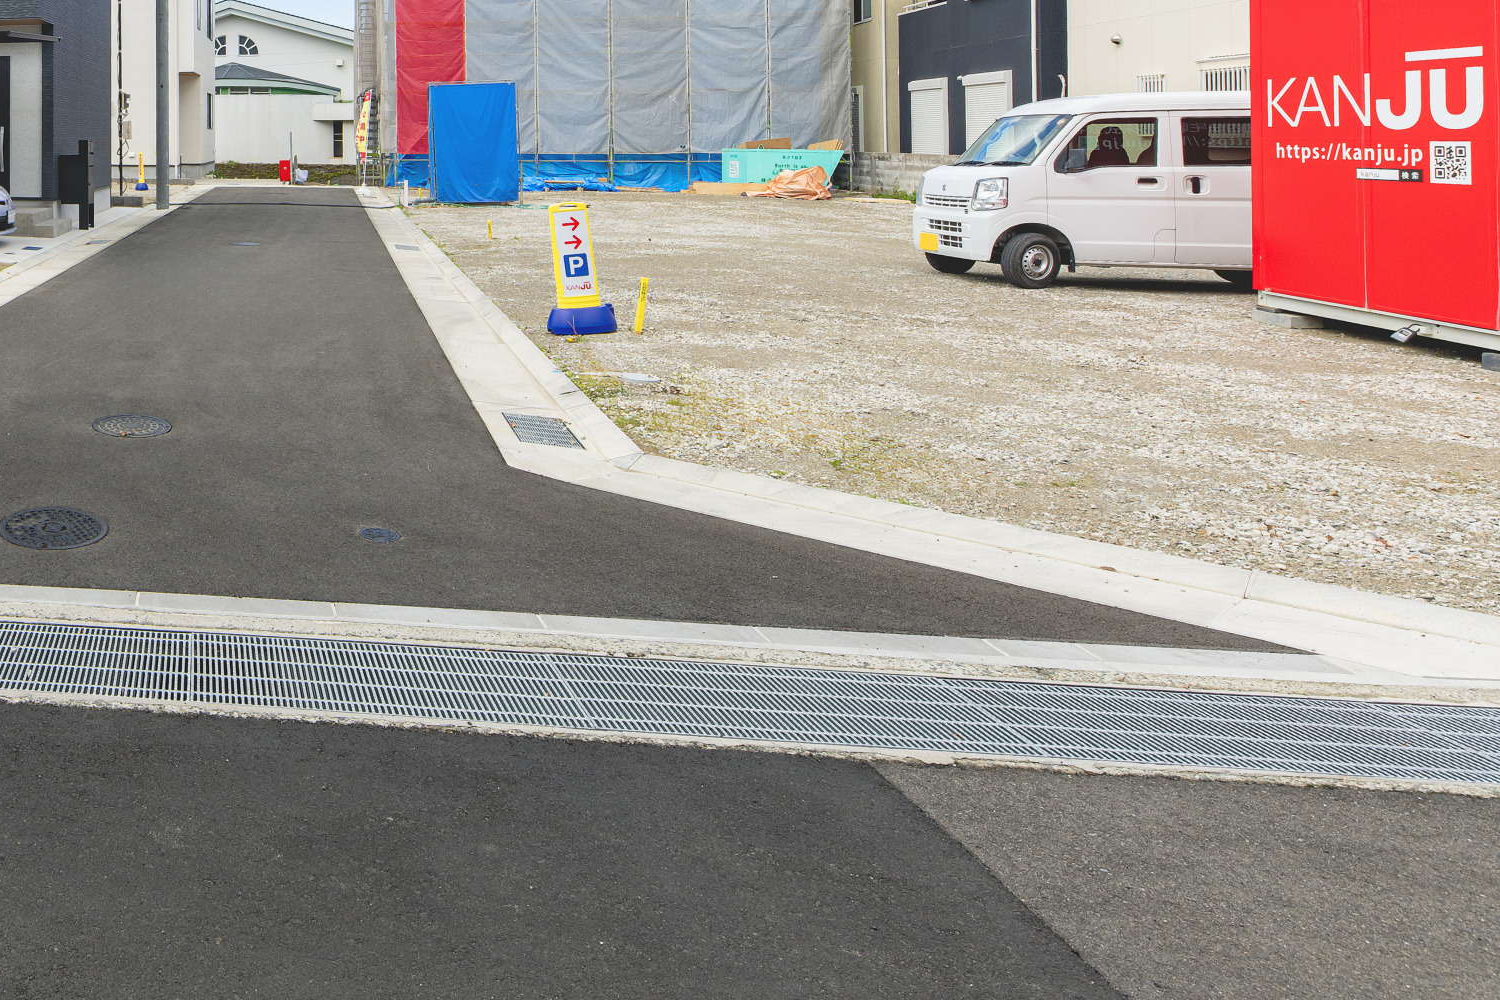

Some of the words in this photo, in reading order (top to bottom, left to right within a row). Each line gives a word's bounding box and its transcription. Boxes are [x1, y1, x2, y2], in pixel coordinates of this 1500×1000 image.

[1267, 46, 1484, 130] KANJU
[1276, 142, 1424, 166] https://kanju.jp
[569, 256, 584, 275] P
